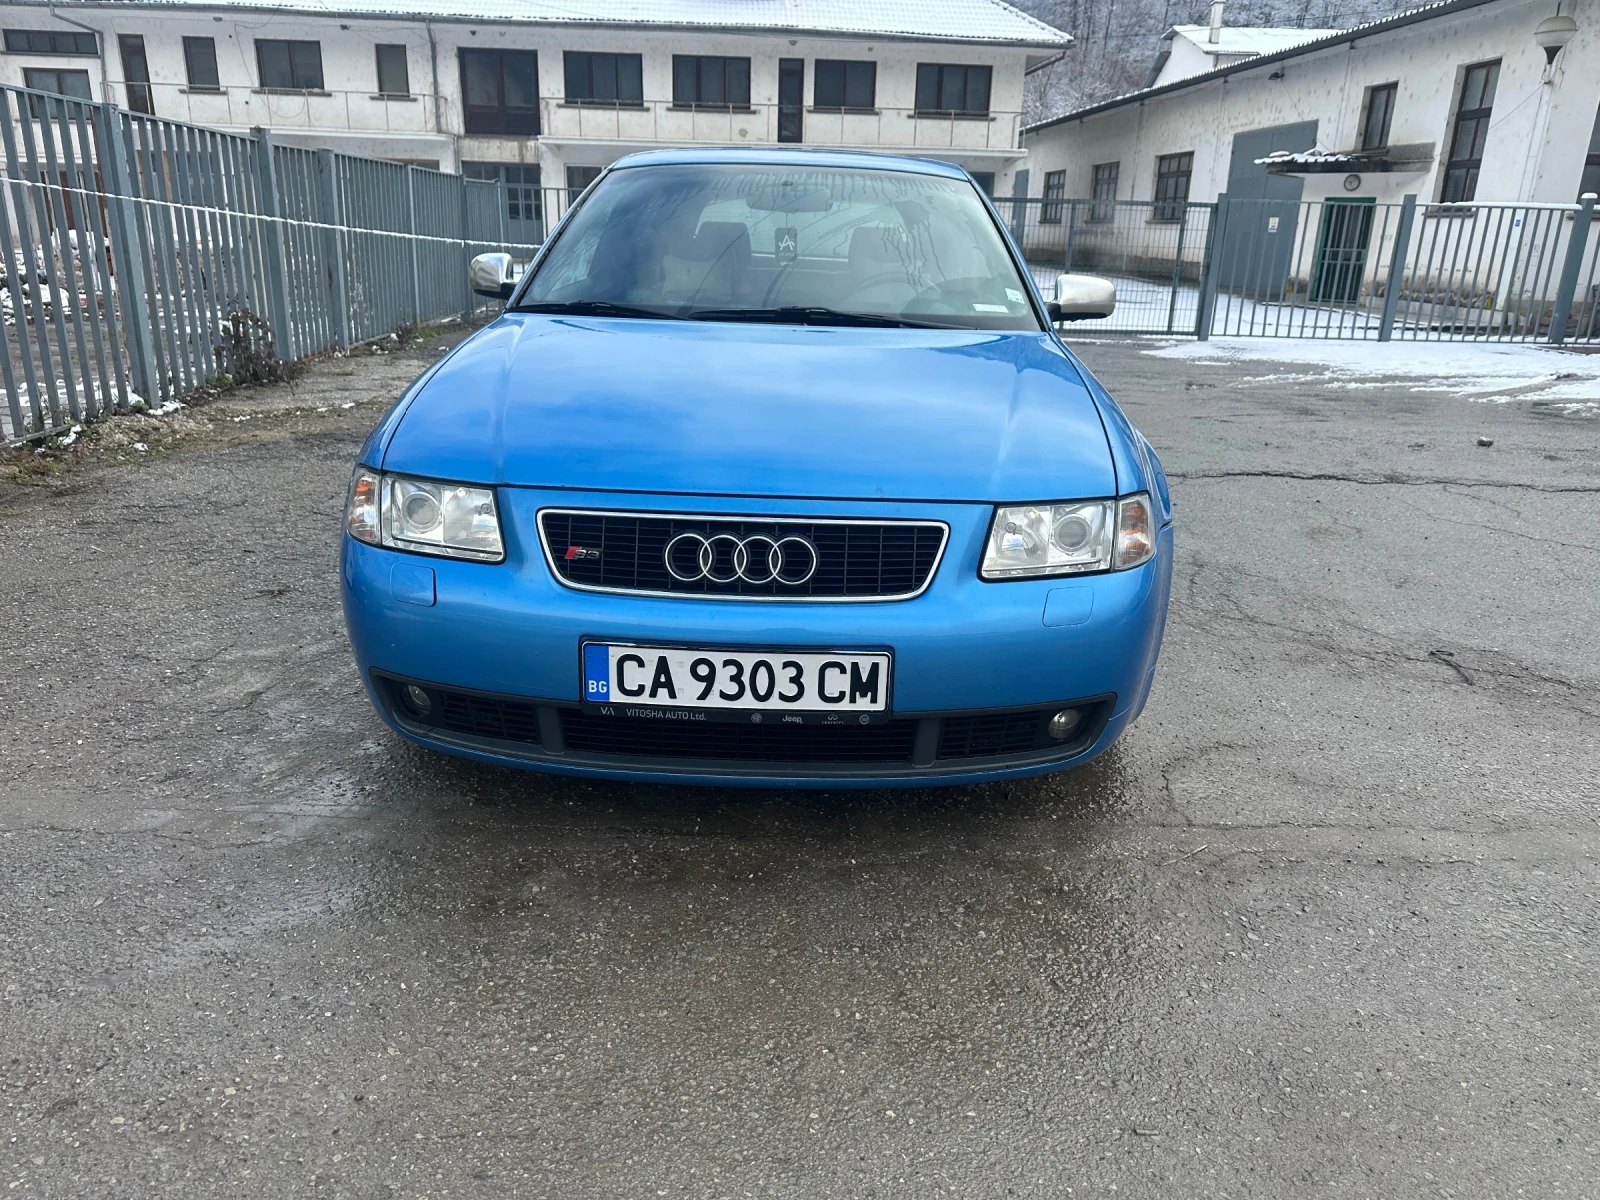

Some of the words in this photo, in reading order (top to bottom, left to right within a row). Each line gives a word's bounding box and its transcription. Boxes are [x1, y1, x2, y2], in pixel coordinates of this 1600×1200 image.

[616, 653, 677, 699] CA
[689, 657, 805, 702] 9303
[817, 660, 879, 704] CM
[588, 679, 607, 693] BG
[626, 708, 664, 719] VITOSHA
[665, 711, 689, 720] AUTO
[690, 712, 707, 721] Ltd.
[782, 714, 802, 724] Jeep
